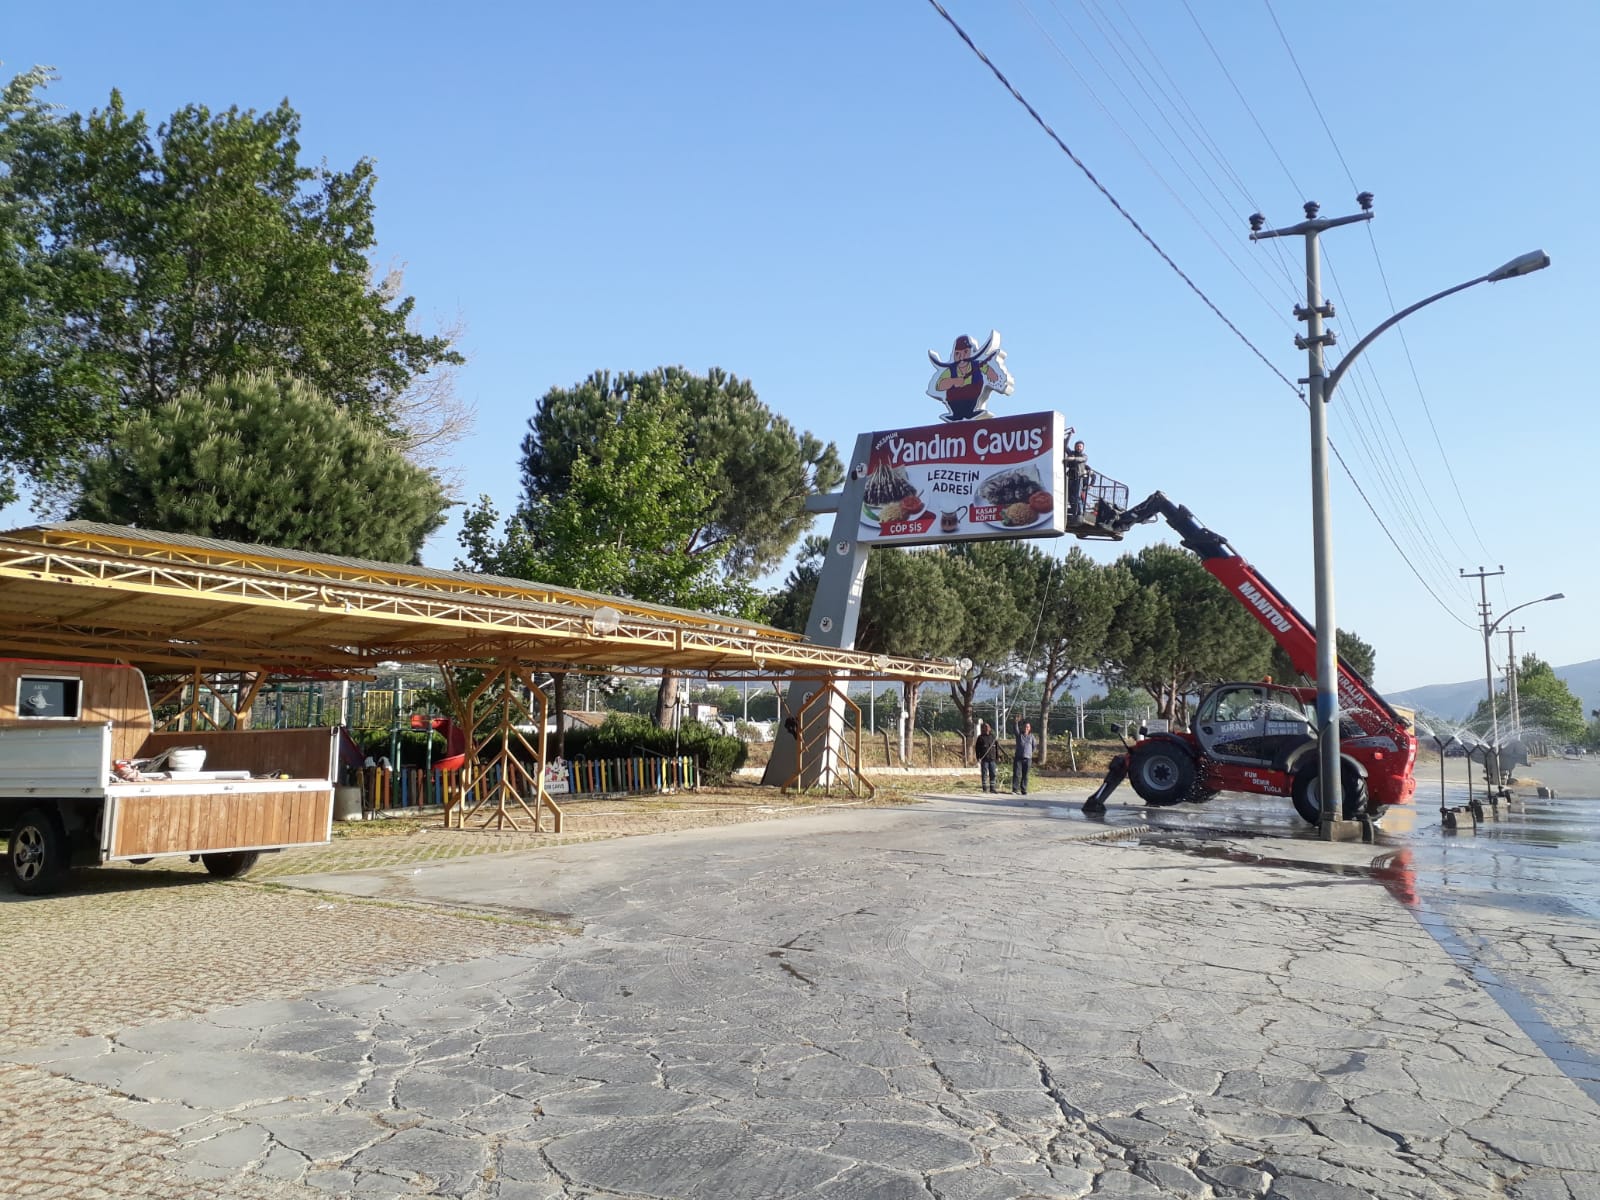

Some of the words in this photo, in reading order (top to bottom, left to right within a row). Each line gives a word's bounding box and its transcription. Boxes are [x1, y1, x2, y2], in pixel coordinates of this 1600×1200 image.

[889, 433, 966, 464] Yandım
[973, 428, 1043, 461] Çavuş
[927, 470, 980, 482] LEZZETİN
[932, 482, 973, 495] ADRESİ
[1238, 580, 1292, 633] MANITOU
